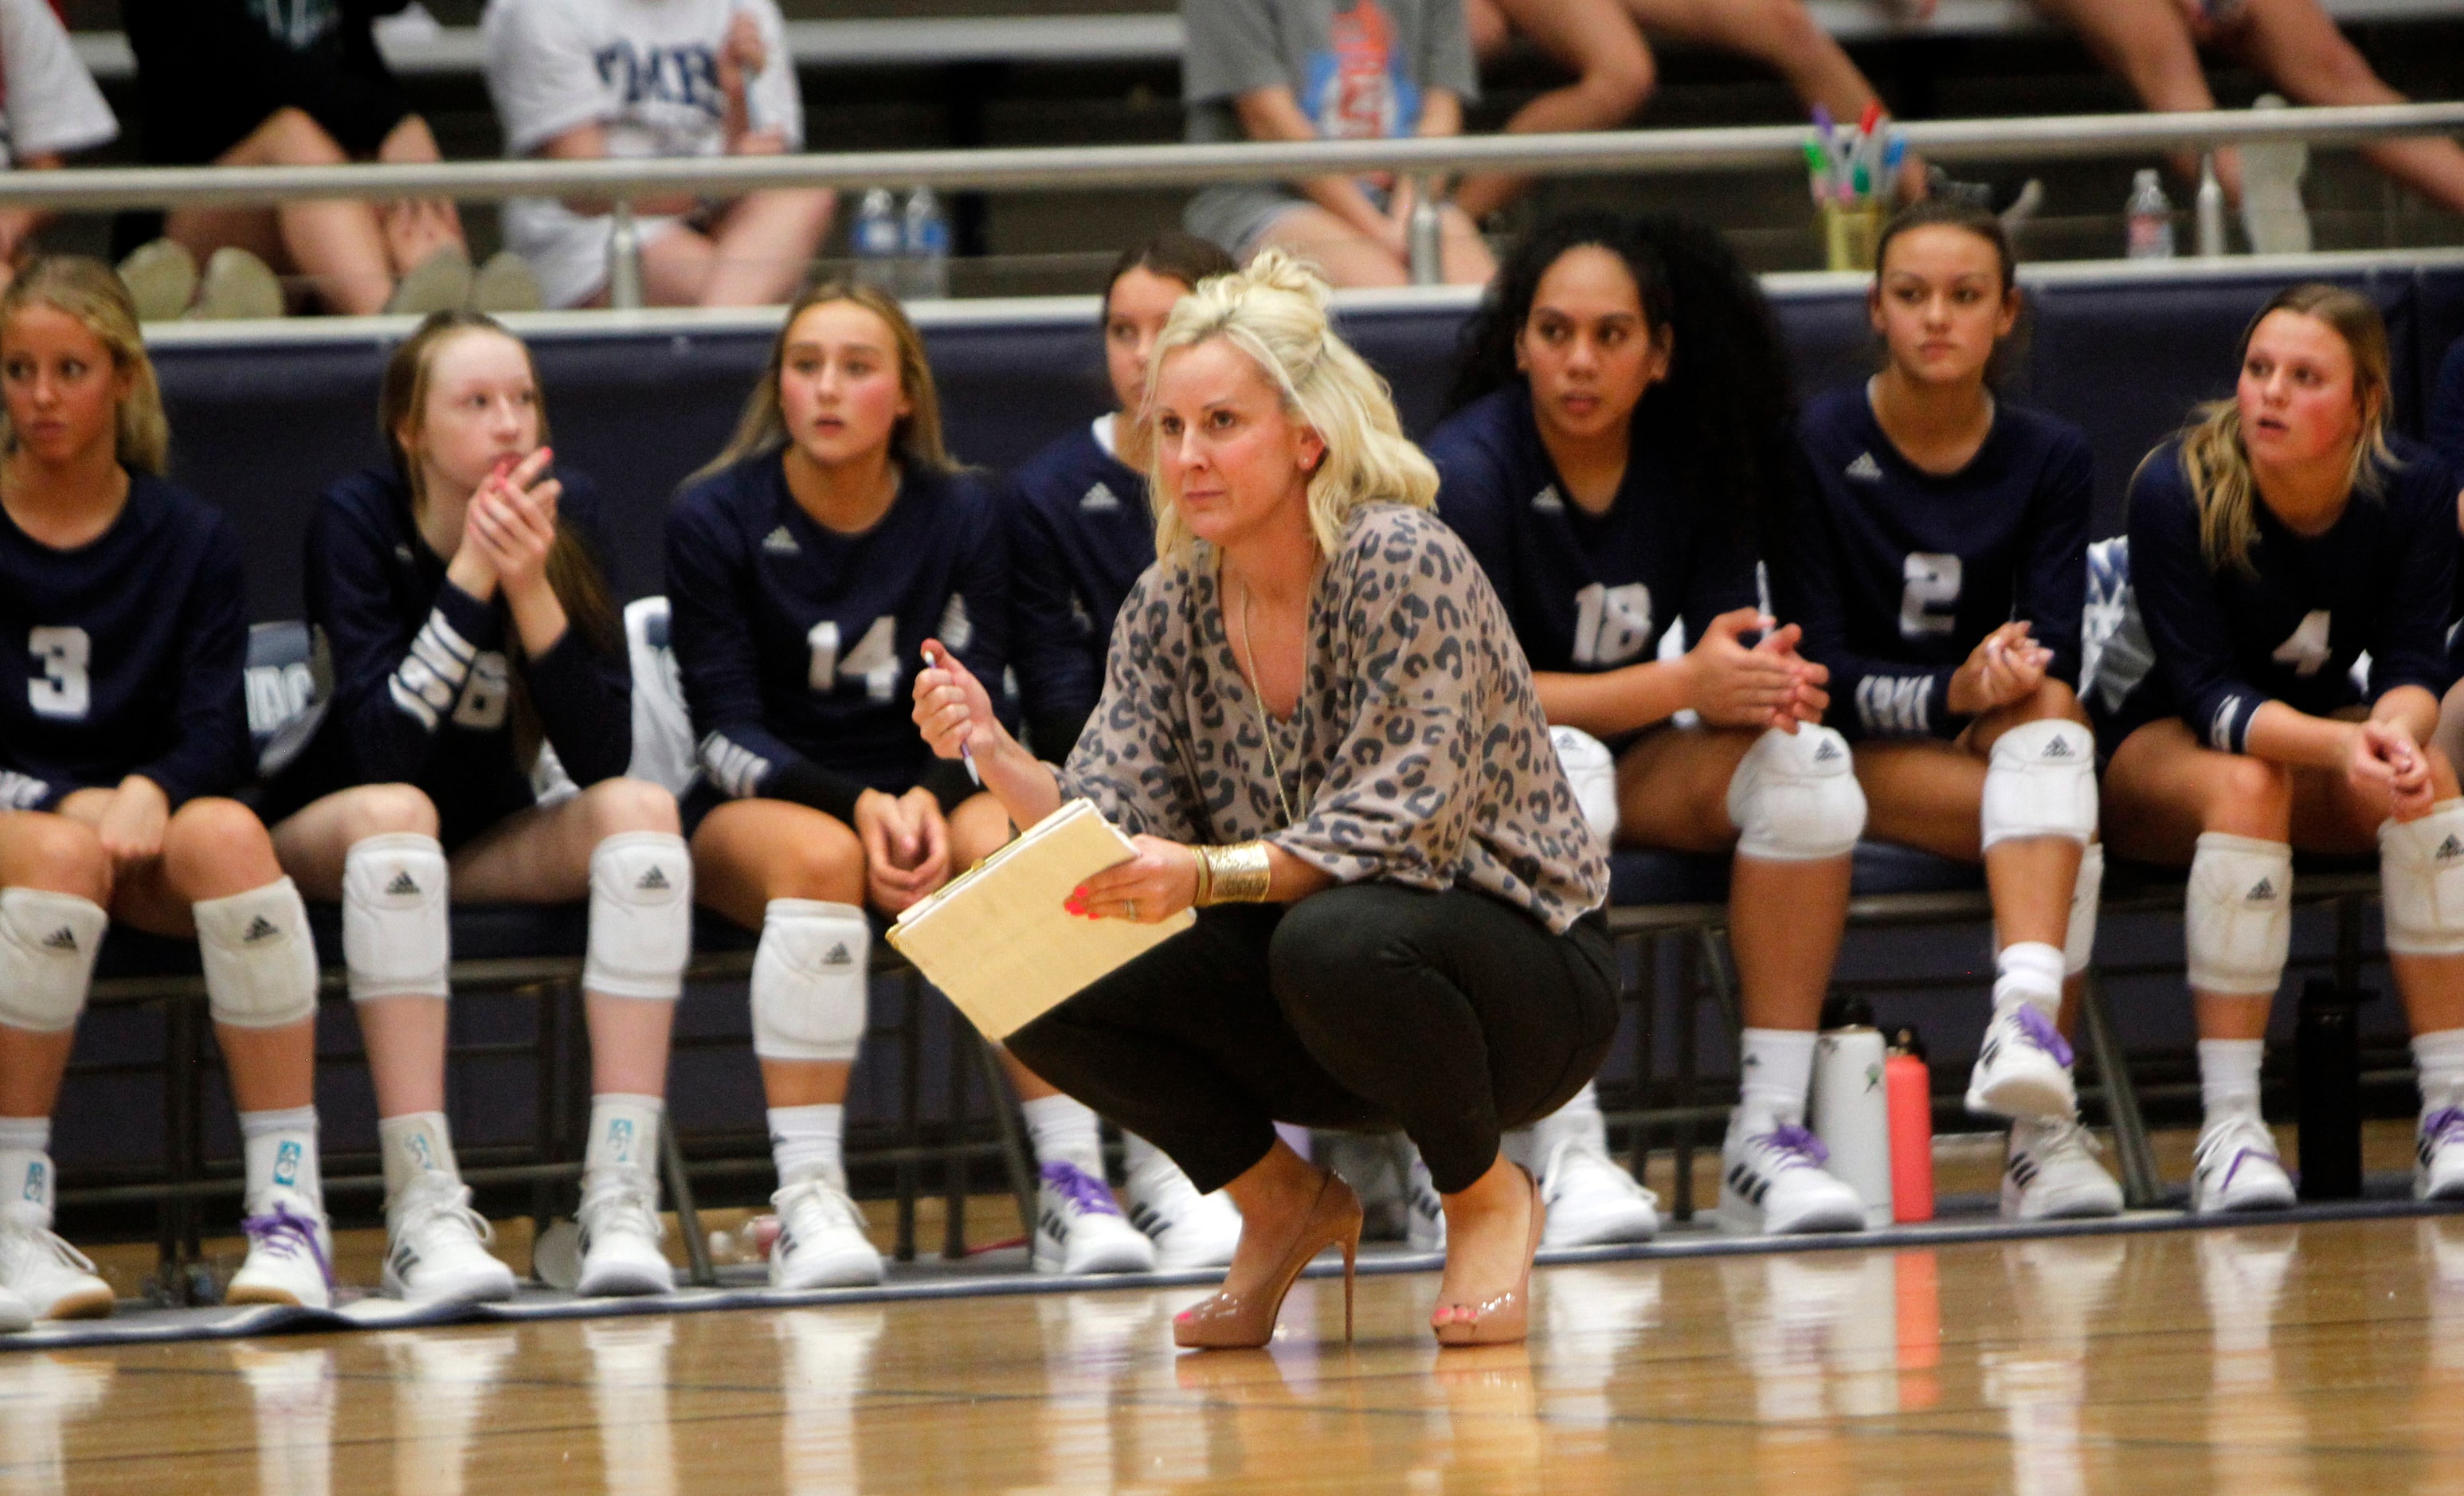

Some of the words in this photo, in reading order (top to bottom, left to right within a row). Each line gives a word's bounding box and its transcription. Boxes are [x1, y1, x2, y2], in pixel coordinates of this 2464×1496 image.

[1572, 582, 1653, 664] 18
[1900, 551, 1962, 640] 2
[28, 625, 90, 719] 3
[807, 614, 901, 701] 14
[2271, 609, 2333, 677] 4
